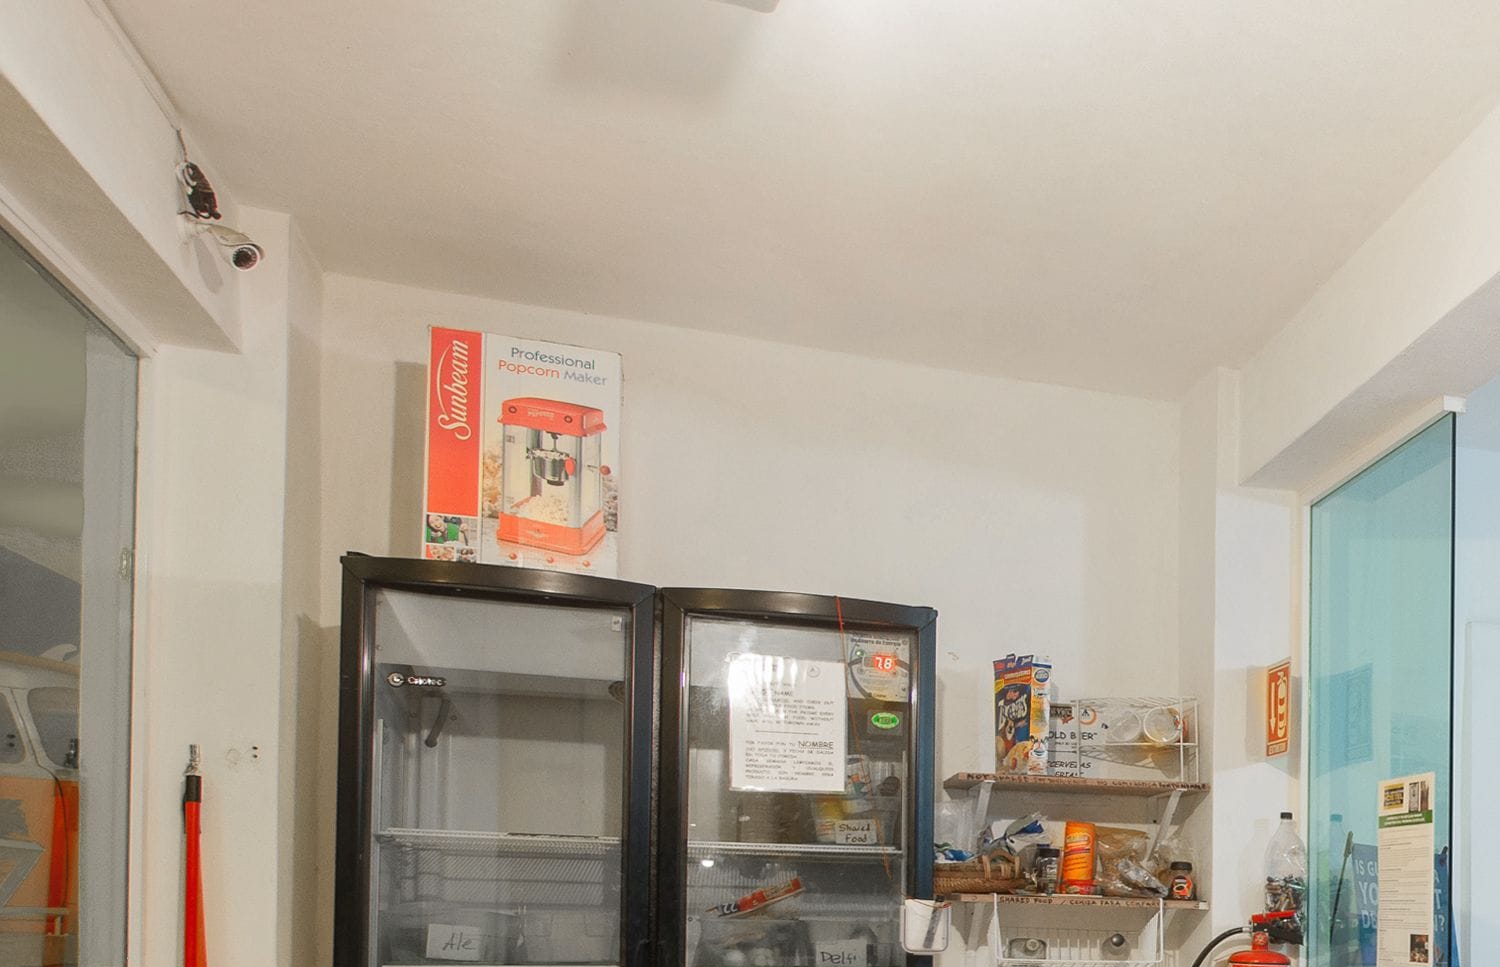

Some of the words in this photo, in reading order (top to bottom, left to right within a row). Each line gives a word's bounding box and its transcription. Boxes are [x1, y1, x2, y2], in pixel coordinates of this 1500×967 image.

[511, 347, 595, 370] Professional
[498, 359, 560, 379] Popcorn
[563, 370, 607, 386] Maker
[437, 340, 472, 441] Sunbeam
[798, 741, 834, 749] NOMBRE
[839, 823, 872, 832] Shared
[845, 833, 868, 843] Food
